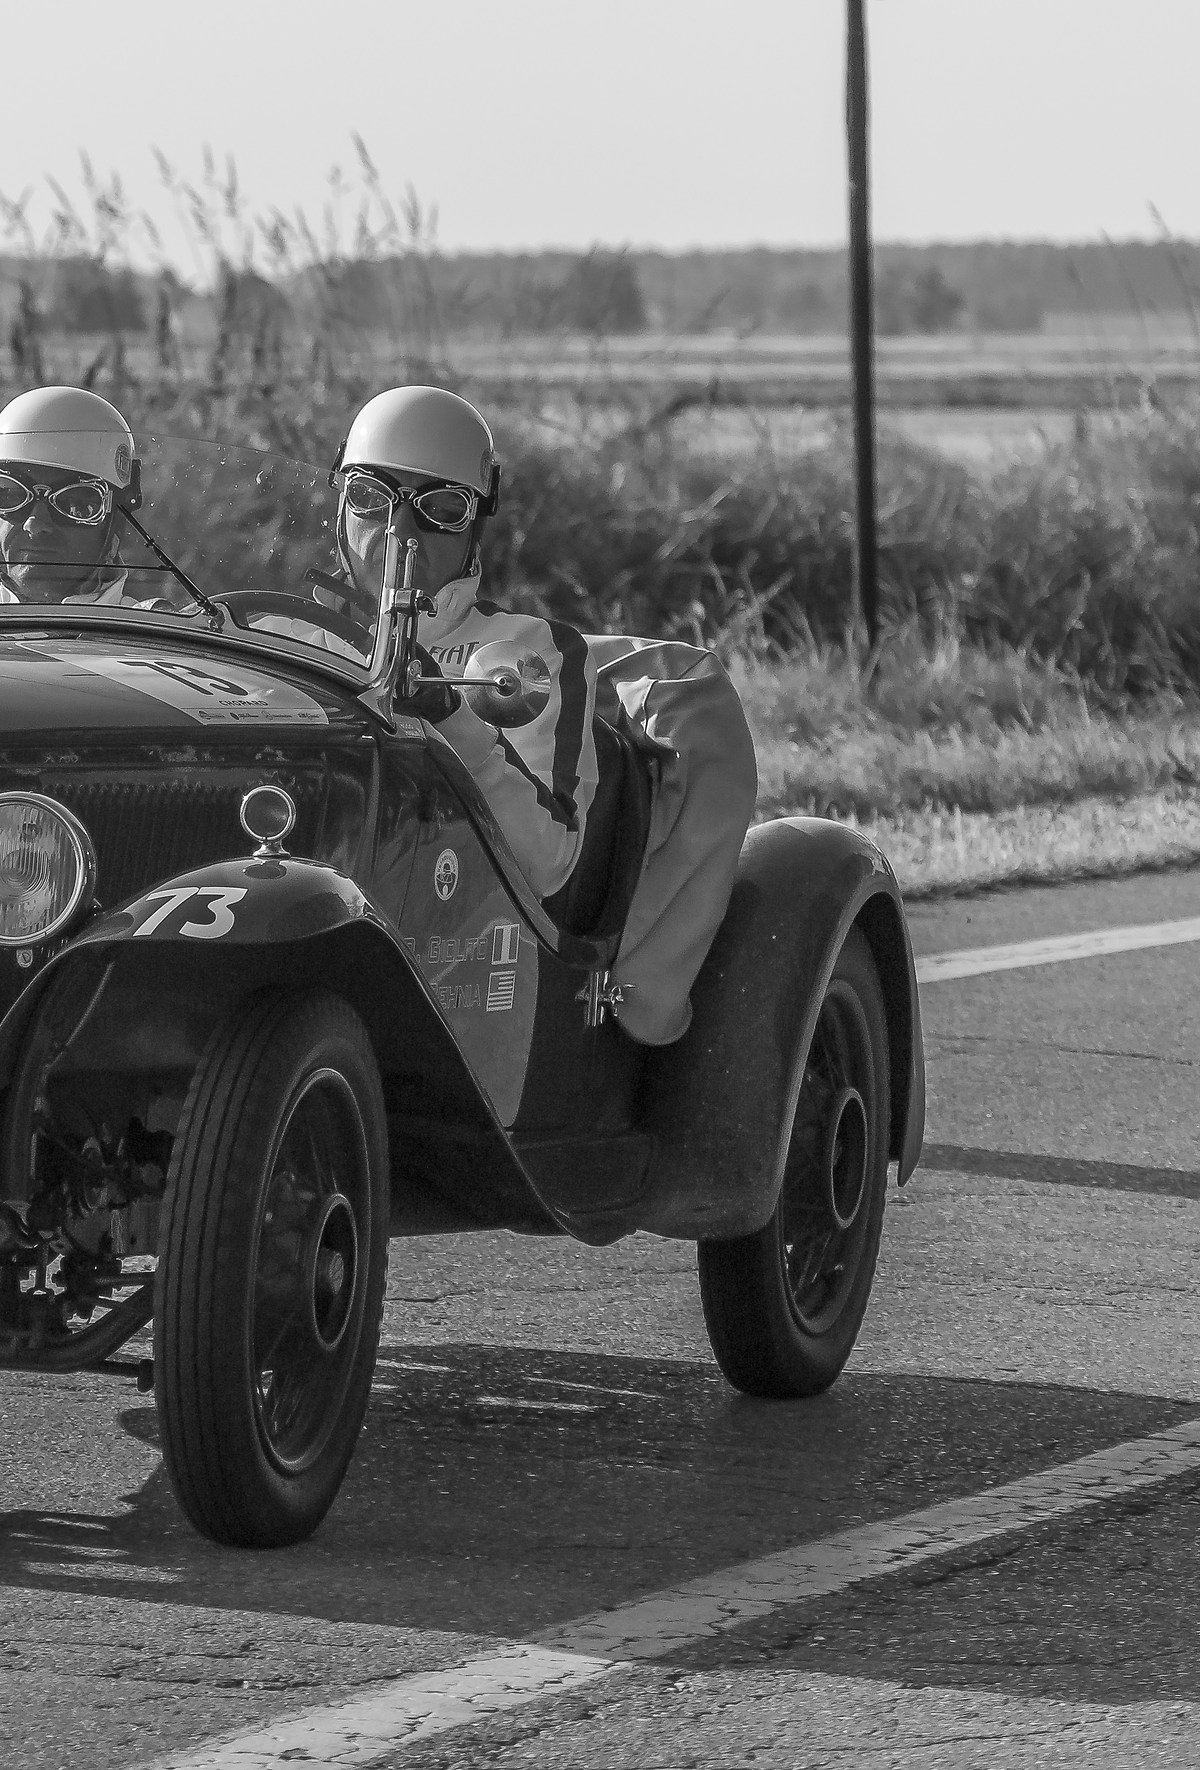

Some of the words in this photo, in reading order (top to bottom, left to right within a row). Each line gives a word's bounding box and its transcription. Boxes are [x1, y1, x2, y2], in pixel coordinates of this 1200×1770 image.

[428, 641, 480, 668] FIAT
[117, 660, 249, 696] 73
[133, 886, 248, 939] 73
